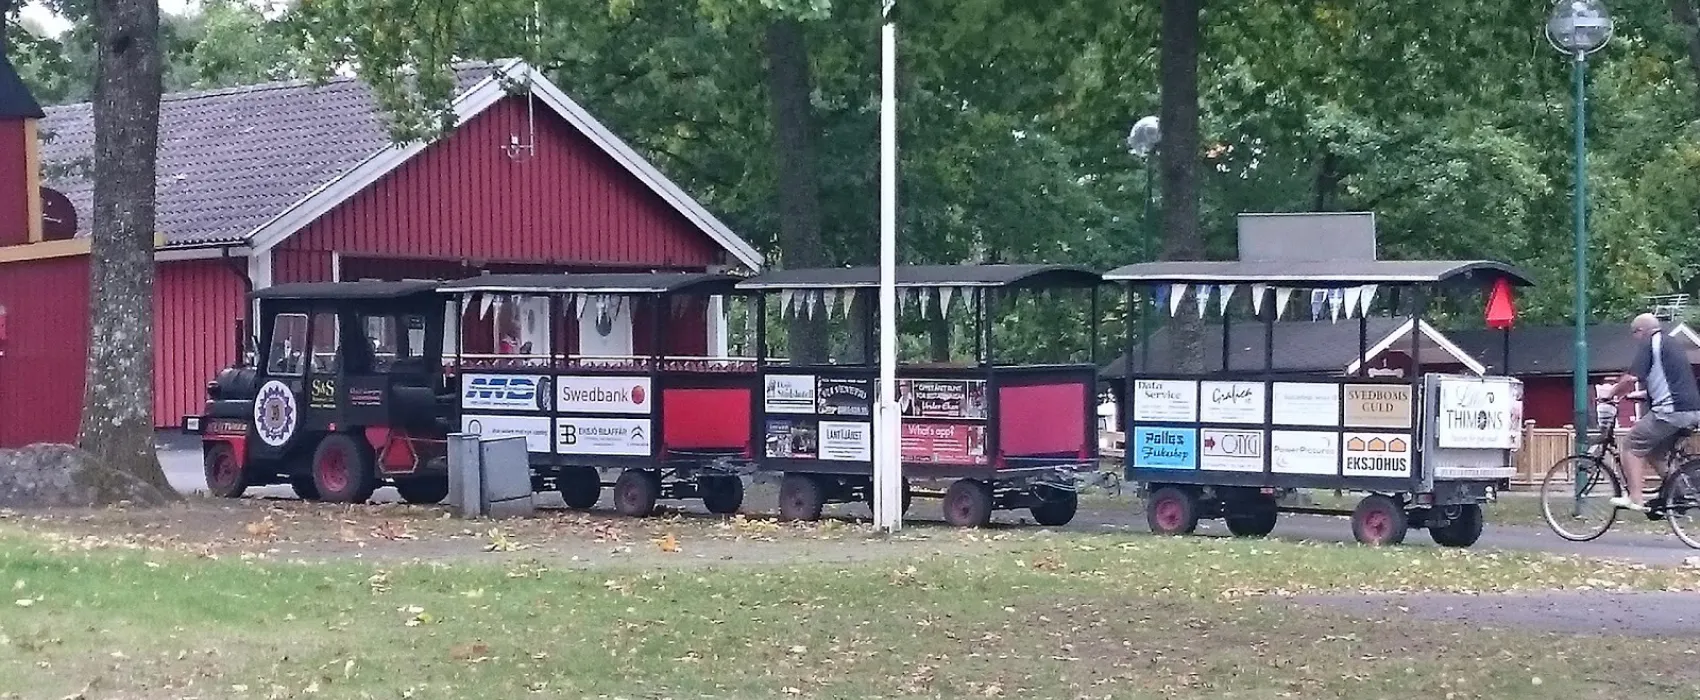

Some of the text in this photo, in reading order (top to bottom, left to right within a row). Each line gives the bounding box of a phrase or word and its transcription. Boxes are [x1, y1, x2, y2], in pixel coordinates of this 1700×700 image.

[1138, 381, 1163, 390] Data
[562, 387, 628, 402] Swedbank
[1145, 390, 1181, 400] Service
[1348, 390, 1408, 400] SVEDBOMS
[1362, 402, 1394, 412] GULD
[1446, 409, 1503, 430] THIMONS
[1346, 454, 1406, 471] EKSJÖHUS
